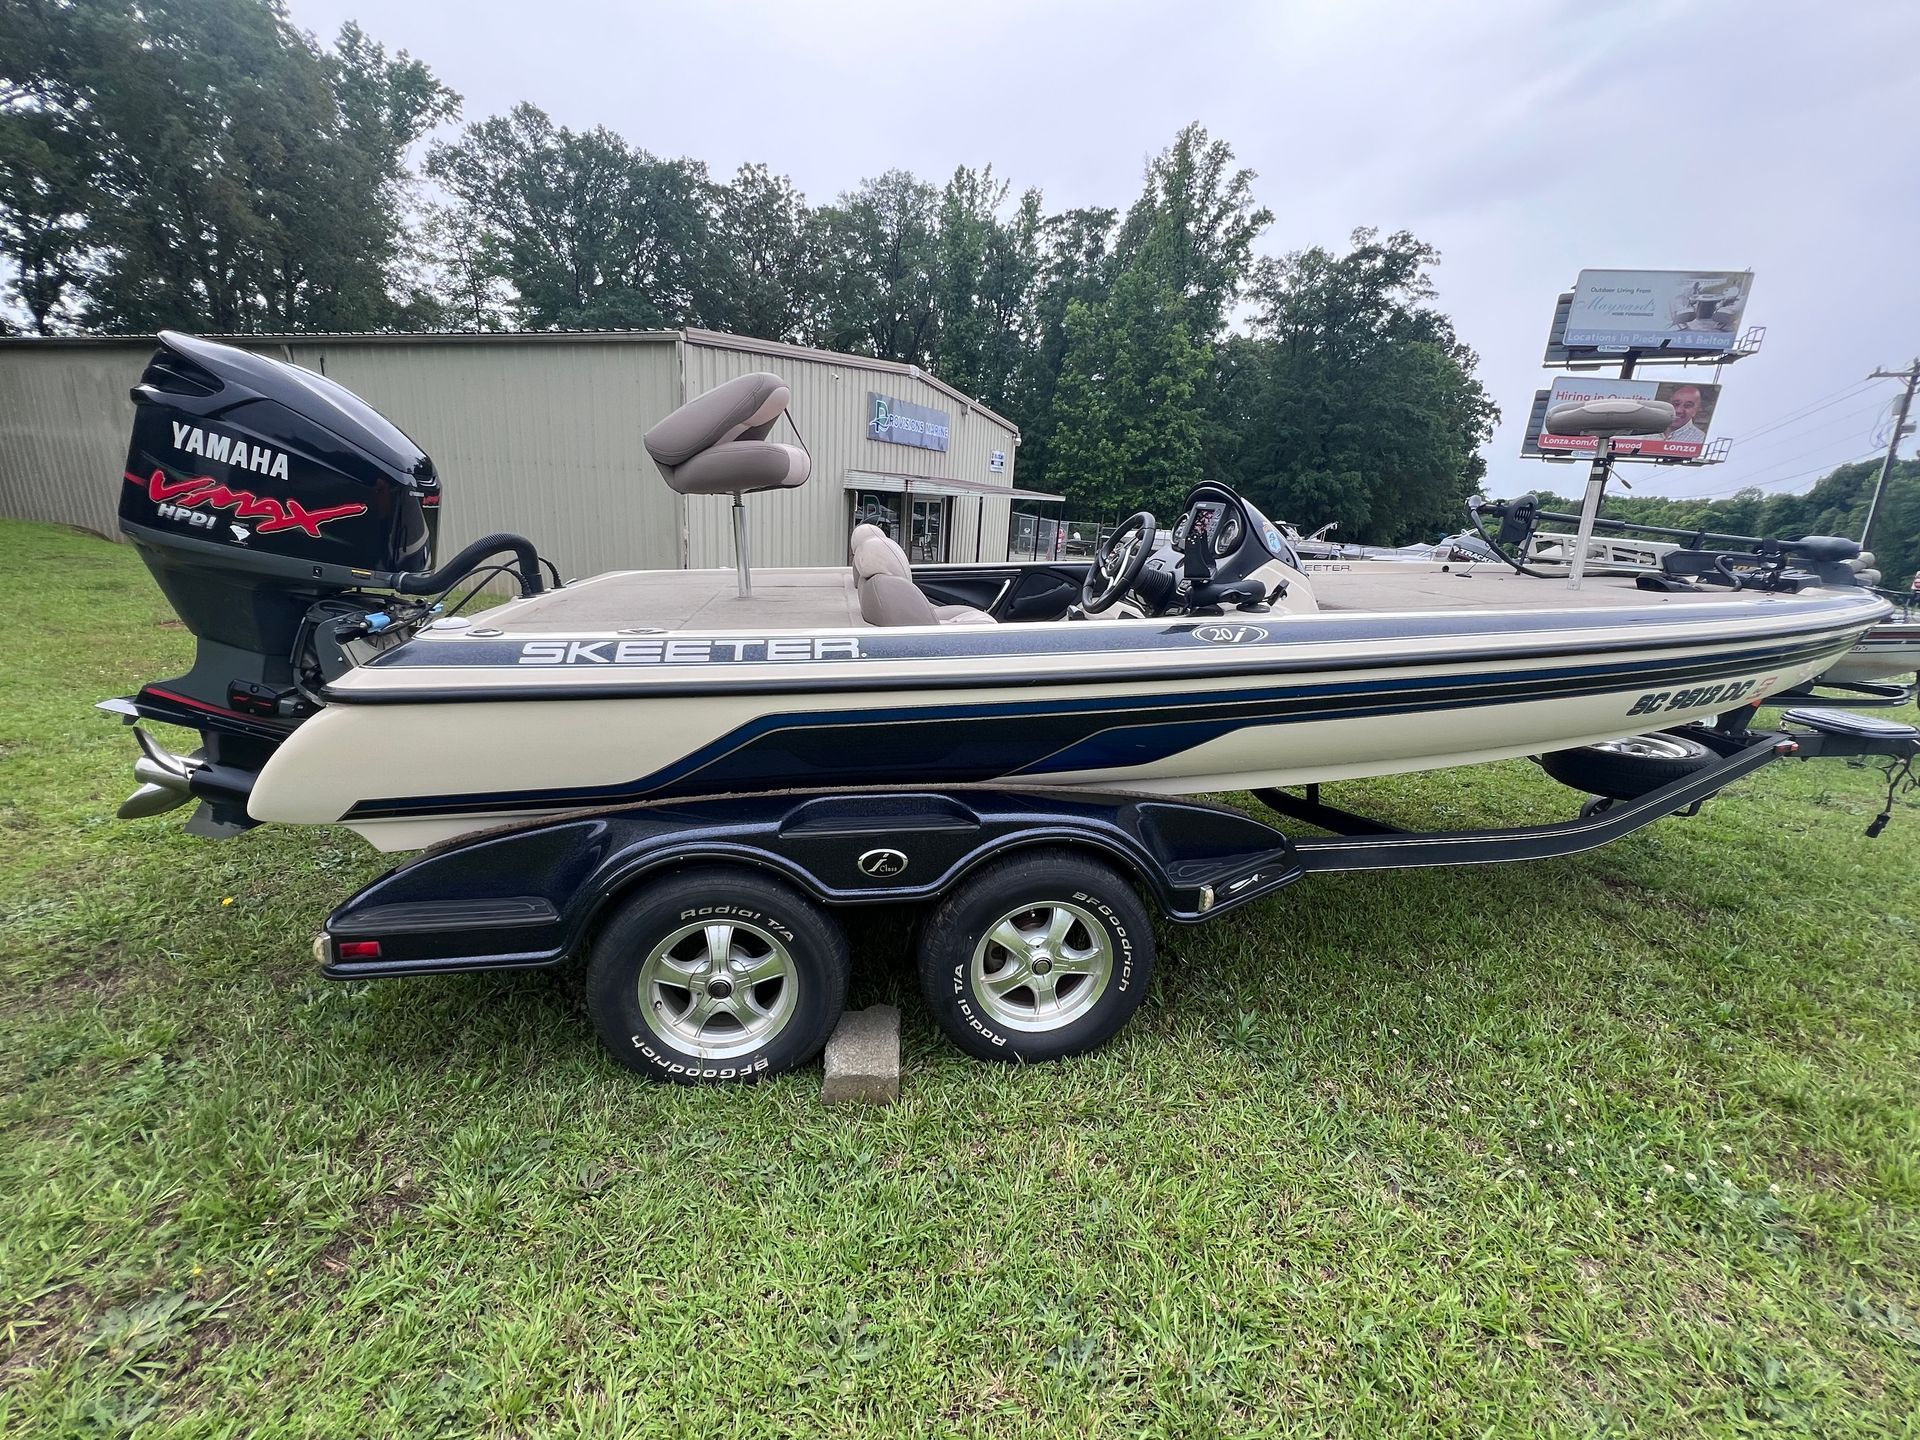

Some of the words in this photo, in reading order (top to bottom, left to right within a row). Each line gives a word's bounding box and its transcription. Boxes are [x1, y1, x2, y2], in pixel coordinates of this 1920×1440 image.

[1568, 333, 1617, 342] Locations
[1620, 334, 1629, 342] in
[1632, 333, 1682, 344] Piedmnt
[1696, 335, 1731, 346] Belton
[1556, 391, 1591, 401] Hiring
[172, 421, 289, 481] YAMAHA
[1663, 444, 1696, 453] Lonza
[157, 503, 217, 530] HPDI
[1460, 548, 1499, 563] TRACK
[518, 638, 860, 664] SKEETER
[1626, 691, 1671, 716] SC
[1714, 679, 1757, 704] DC
[680, 905, 761, 921] Radial
[767, 918, 795, 943] T/A
[1071, 891, 1135, 992] BFGoodrich
[953, 963, 964, 994] T/A
[957, 999, 1007, 1047] Radial
[631, 1034, 769, 1079] BFGoodrich
